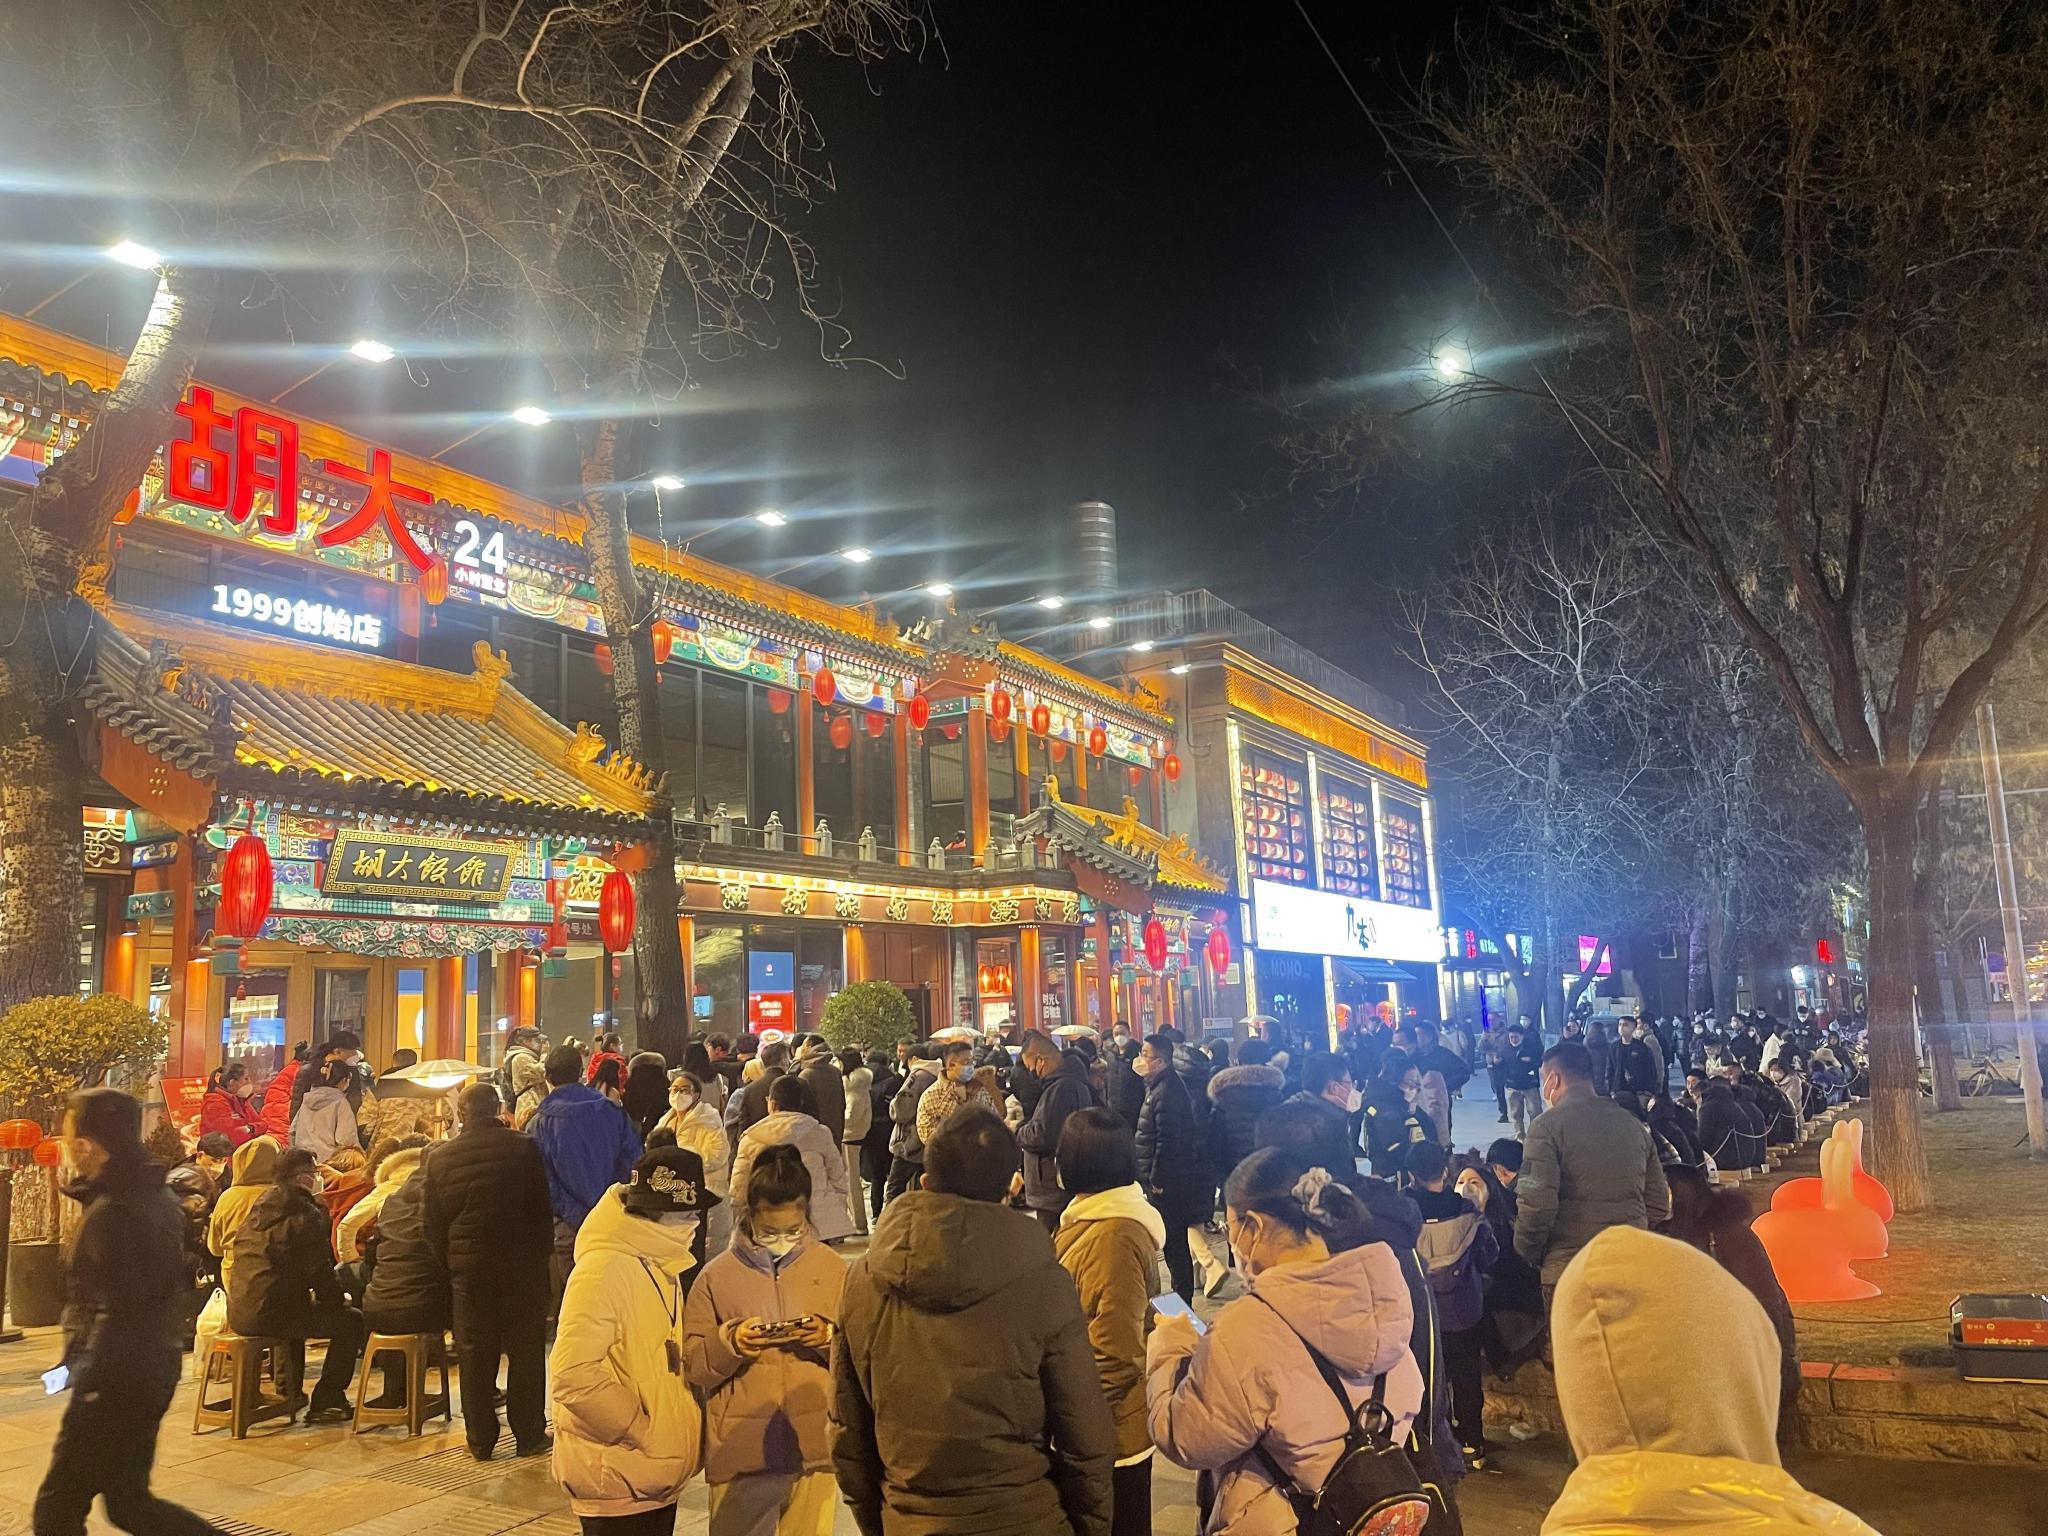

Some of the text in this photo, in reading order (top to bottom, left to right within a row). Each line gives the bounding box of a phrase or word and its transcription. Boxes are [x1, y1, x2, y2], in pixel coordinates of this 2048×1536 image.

[169, 385, 436, 575] 胡大
[453, 519, 508, 575] 24
[211, 584, 382, 648] 1999创始店
